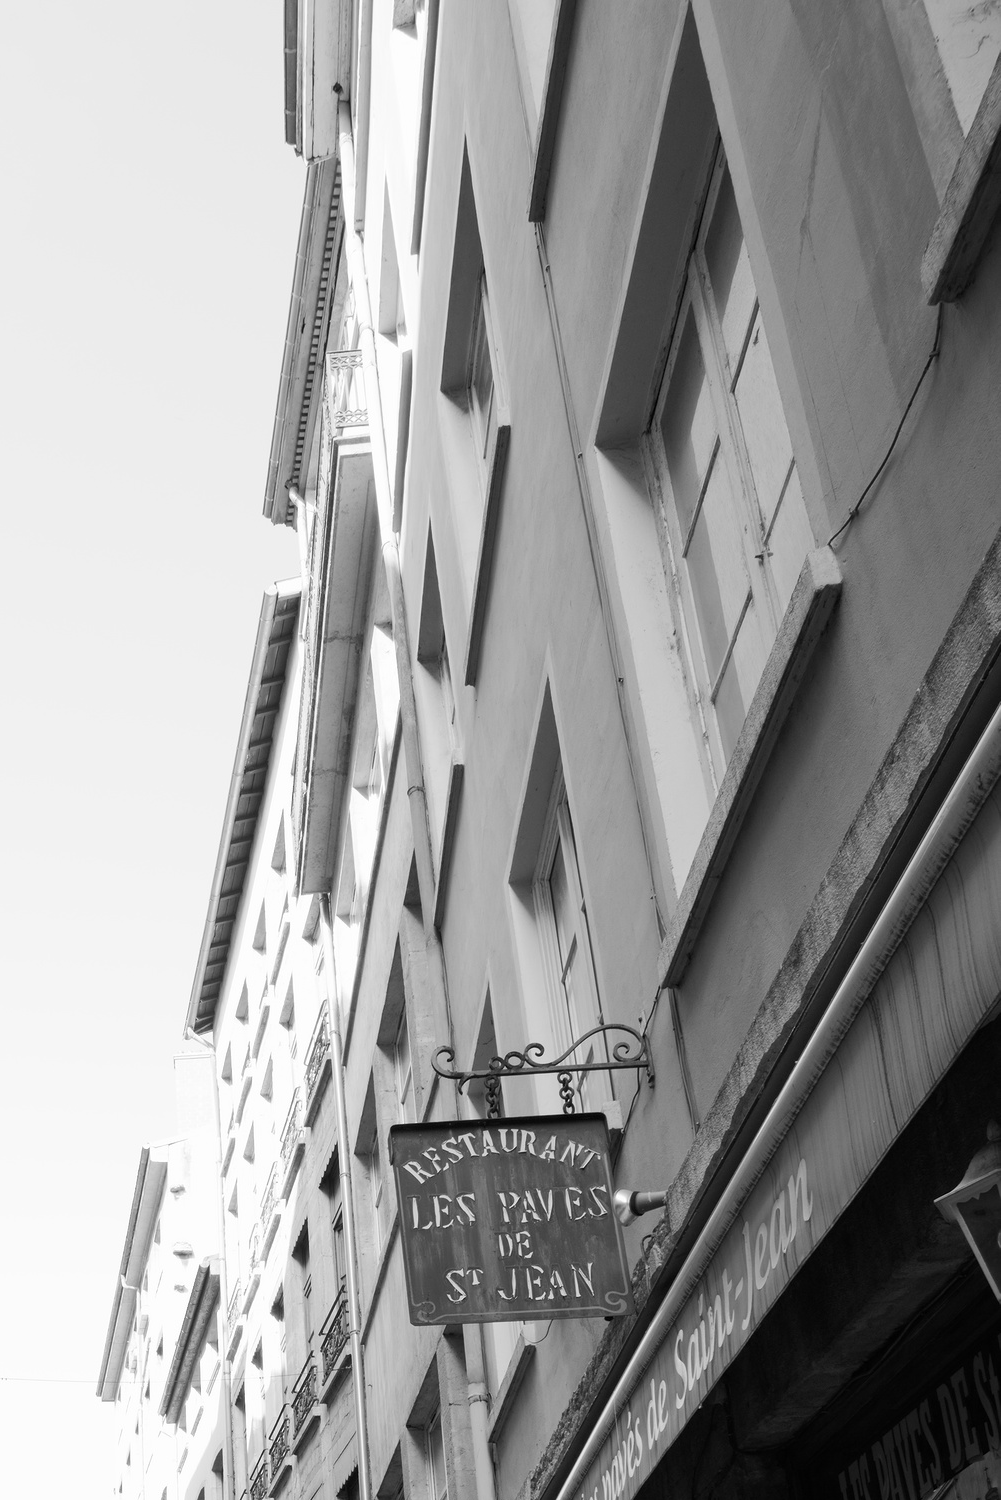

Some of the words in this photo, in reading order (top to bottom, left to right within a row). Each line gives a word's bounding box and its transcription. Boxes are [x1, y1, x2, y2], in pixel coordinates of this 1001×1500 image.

[402, 1128, 602, 1185] RESTAURANT
[409, 1191, 477, 1231] LES
[498, 1230, 535, 1260] DE
[498, 1262, 596, 1301] JEAN
[647, 1379, 669, 1450] de
[673, 1158, 814, 1411] Saint-Jean
[937, 1367, 984, 1475] DE
